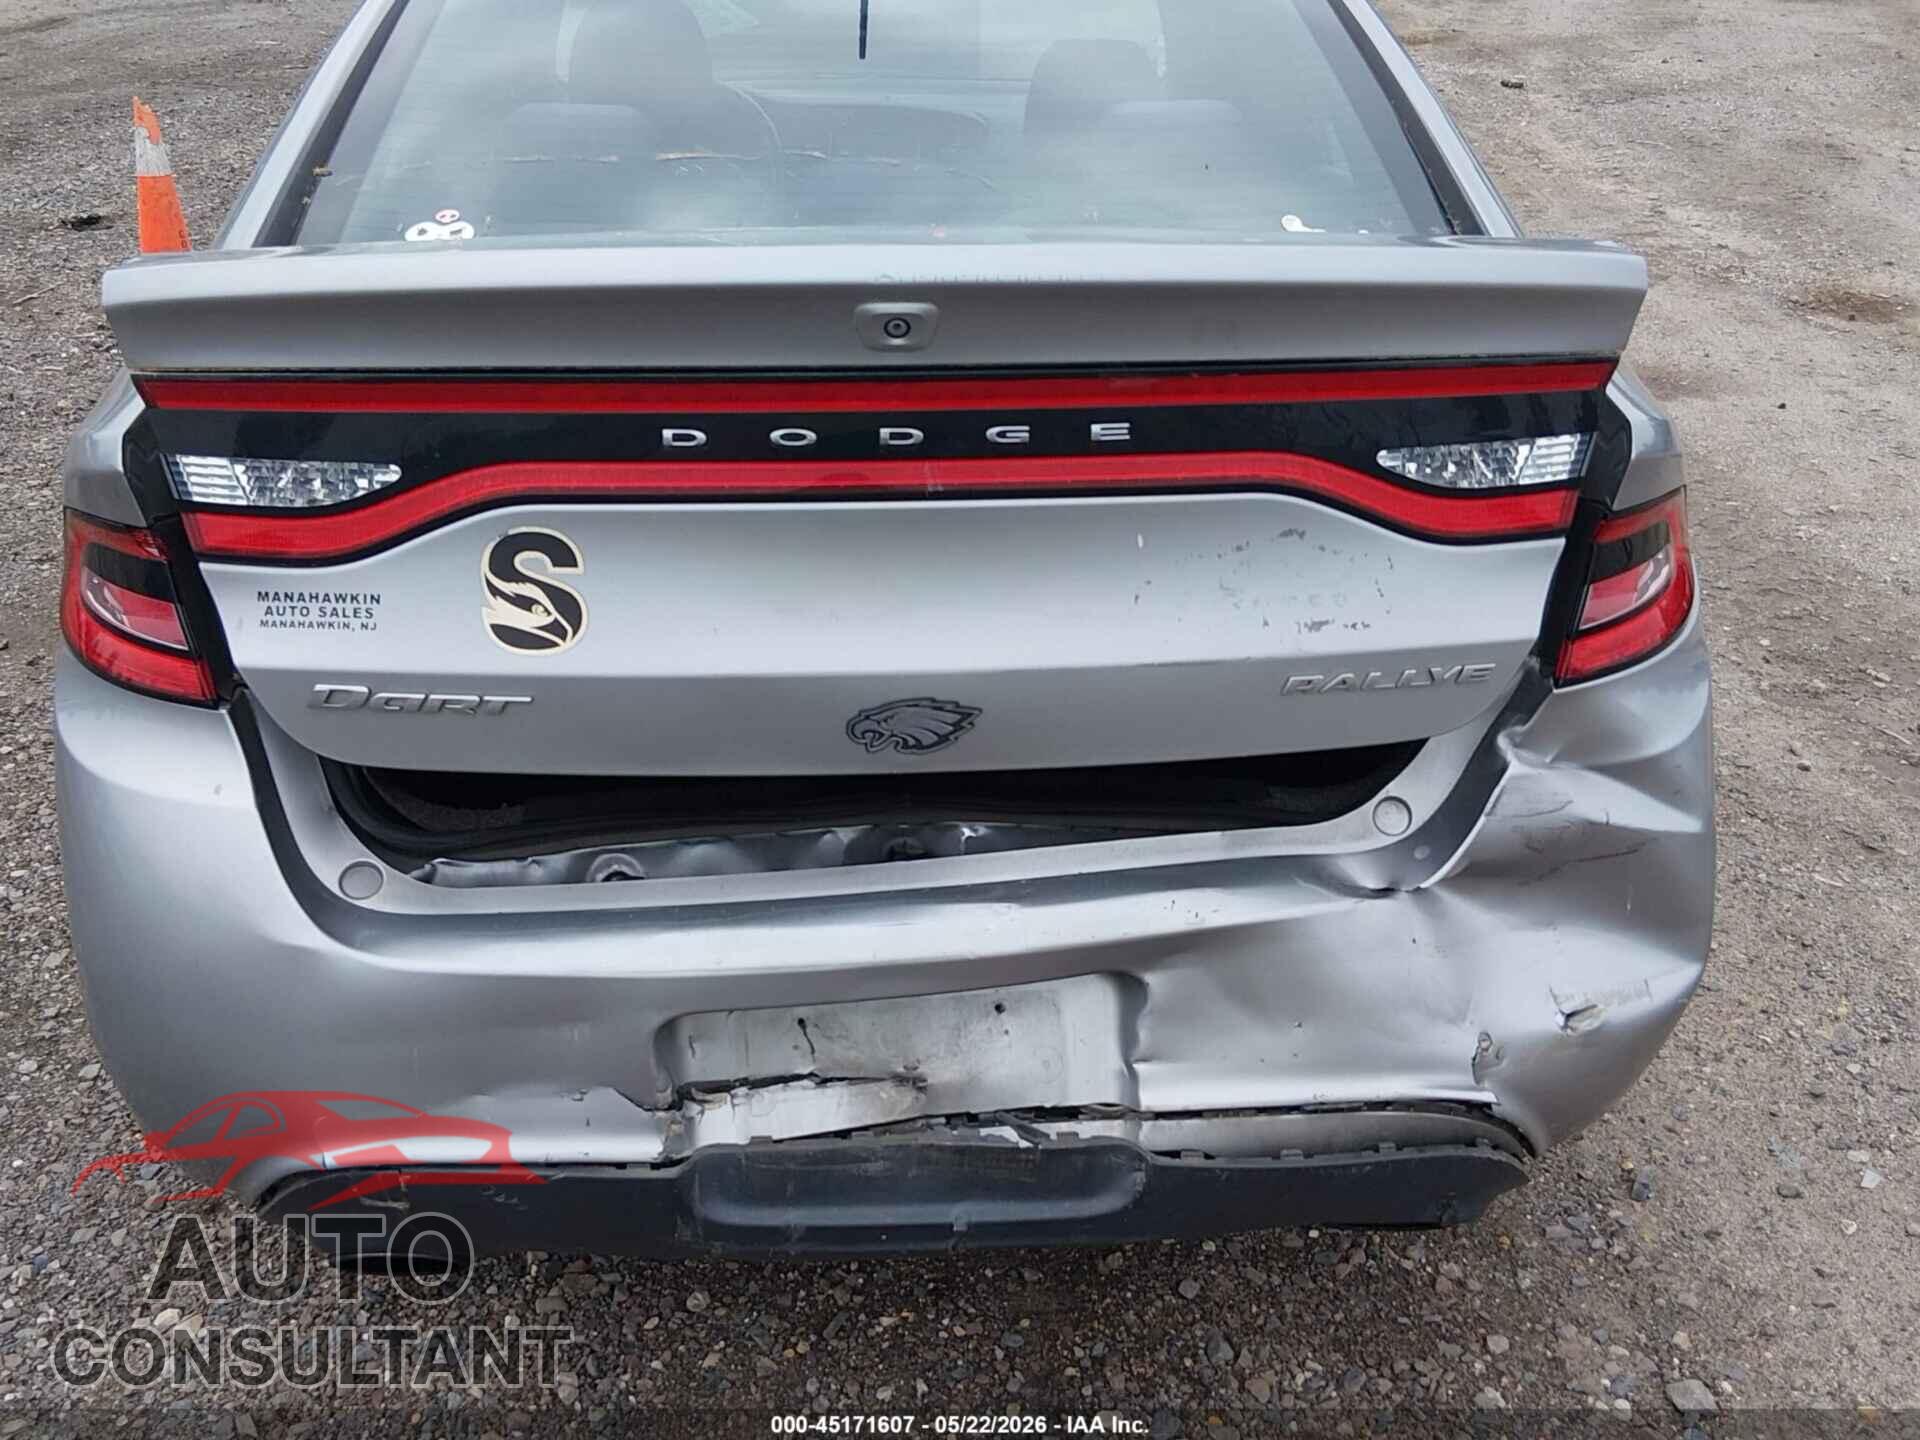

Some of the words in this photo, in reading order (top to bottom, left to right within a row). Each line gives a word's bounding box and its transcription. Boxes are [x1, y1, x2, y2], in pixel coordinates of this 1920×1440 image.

[660, 422, 1131, 447] DODGE
[257, 591, 381, 605] MANAHAWKIN
[264, 605, 310, 617] AUTO
[318, 606, 374, 619] SALES
[260, 619, 355, 632] MANAHAWKIN,
[360, 621, 377, 631] NJ
[1281, 663, 1496, 695] RALLYE
